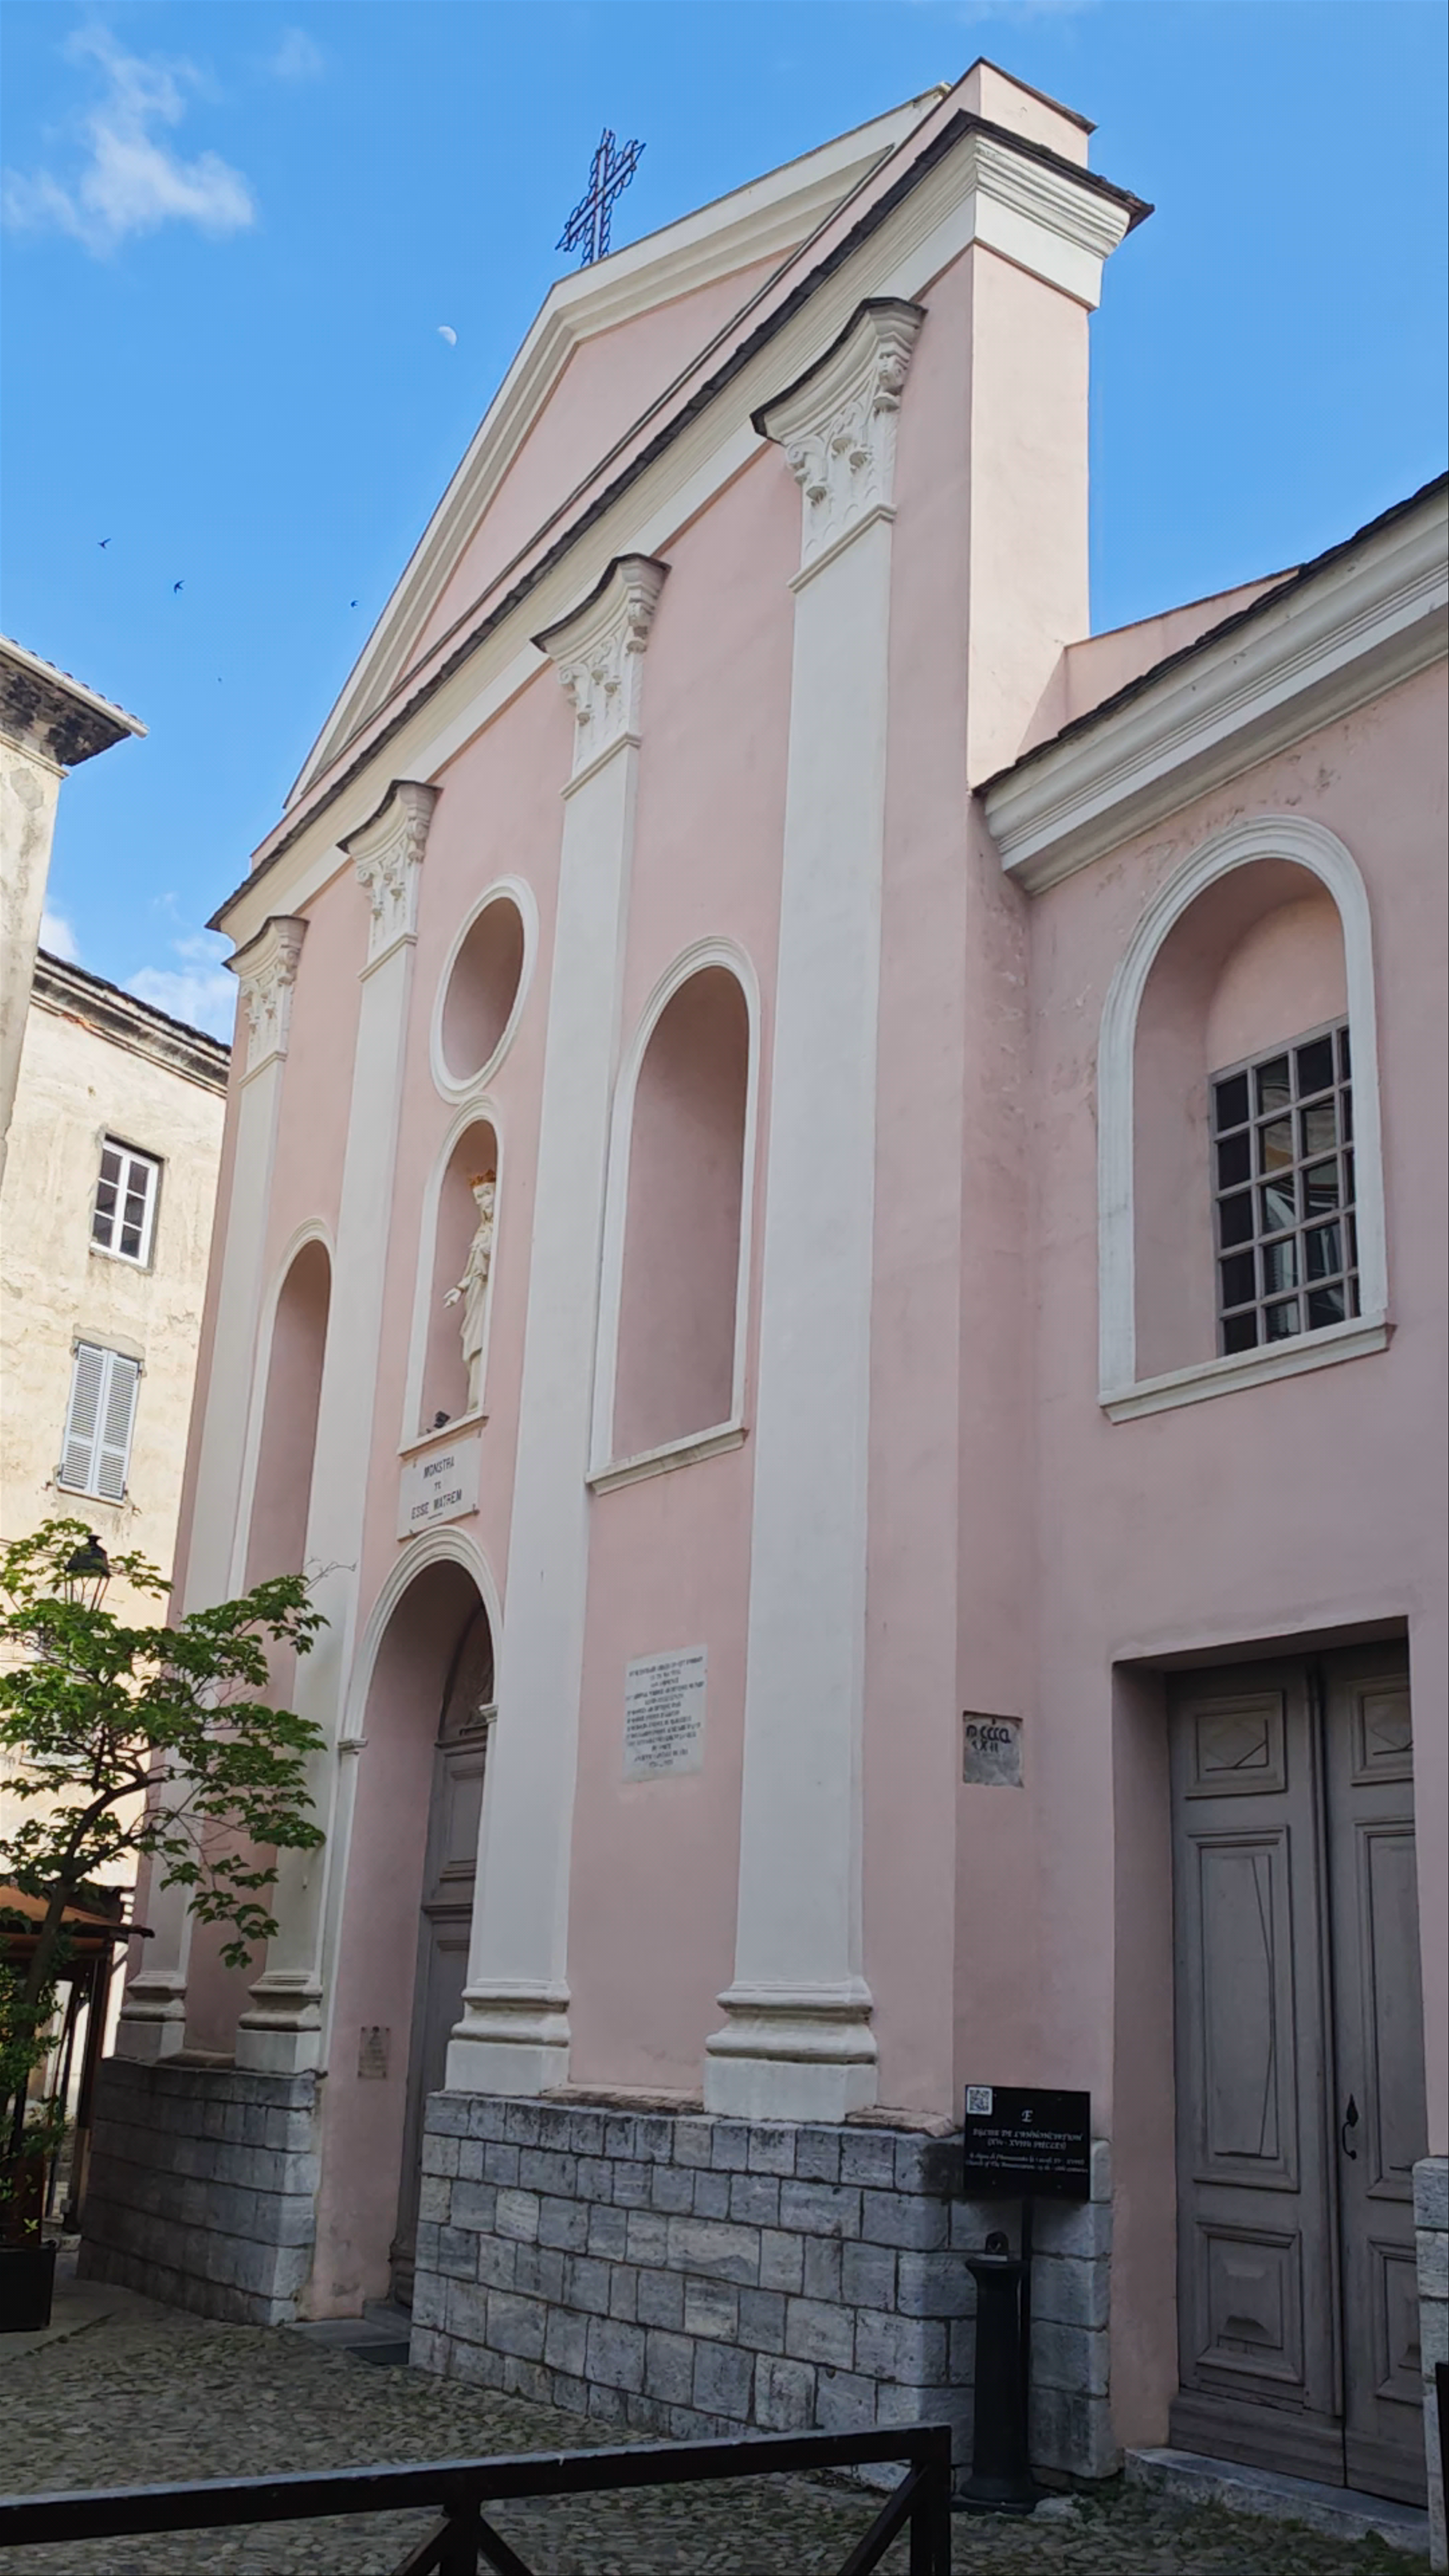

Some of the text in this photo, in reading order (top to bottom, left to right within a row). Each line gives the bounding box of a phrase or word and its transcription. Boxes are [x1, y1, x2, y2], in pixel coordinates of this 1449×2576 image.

[423, 1455, 455, 1479] MONSTRA
[411, 1488, 462, 1520] ESSE MATREM
